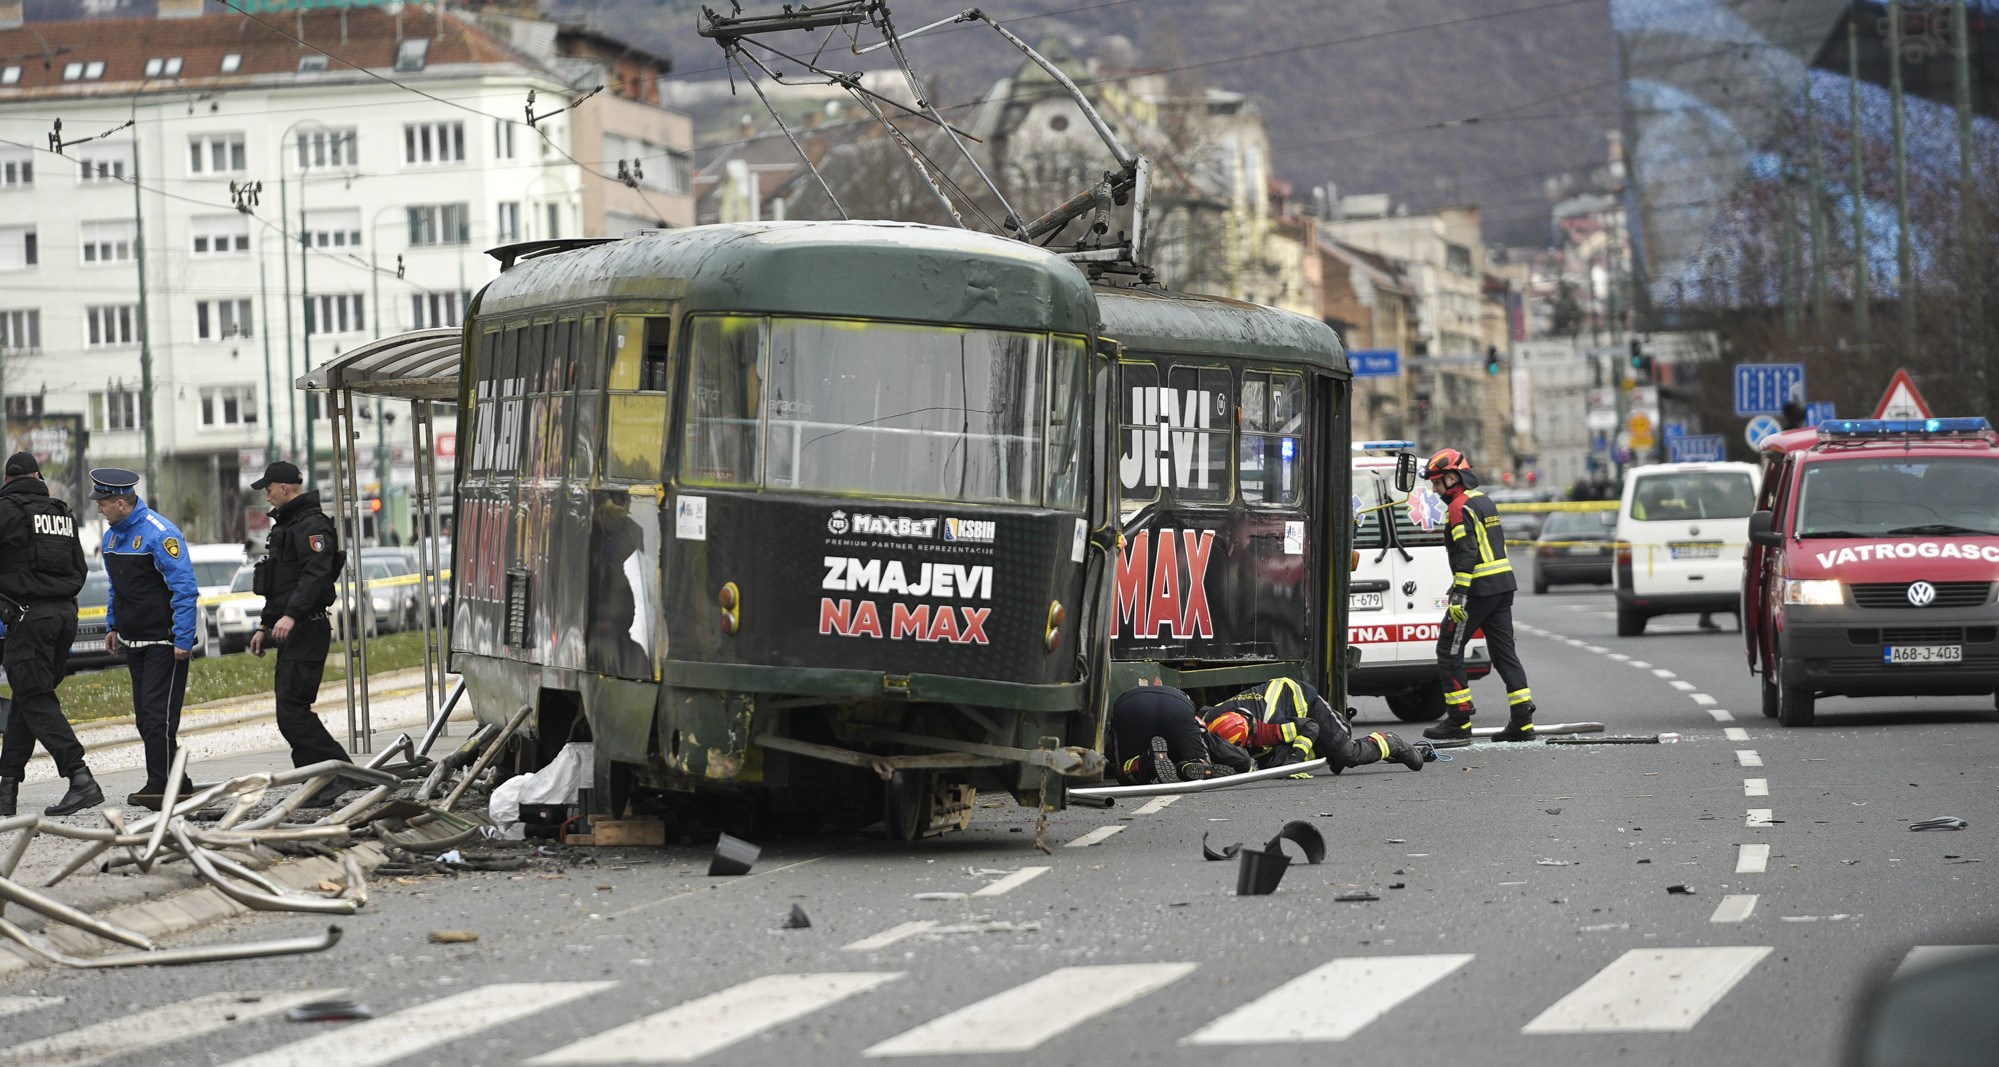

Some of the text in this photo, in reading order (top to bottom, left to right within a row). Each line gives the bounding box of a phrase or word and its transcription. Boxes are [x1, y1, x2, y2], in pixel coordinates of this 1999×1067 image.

[34, 514, 74, 538] POLICIJA
[957, 519, 996, 539] KSBIH
[825, 538, 994, 555] PREMIUM PARTNER REPREZENTACIJE
[822, 556, 994, 600] ZMAJEVI
[1110, 528, 1216, 639] MAX
[818, 597, 992, 645] NA MAX
[1893, 646, 1960, 661] A68-J-403
